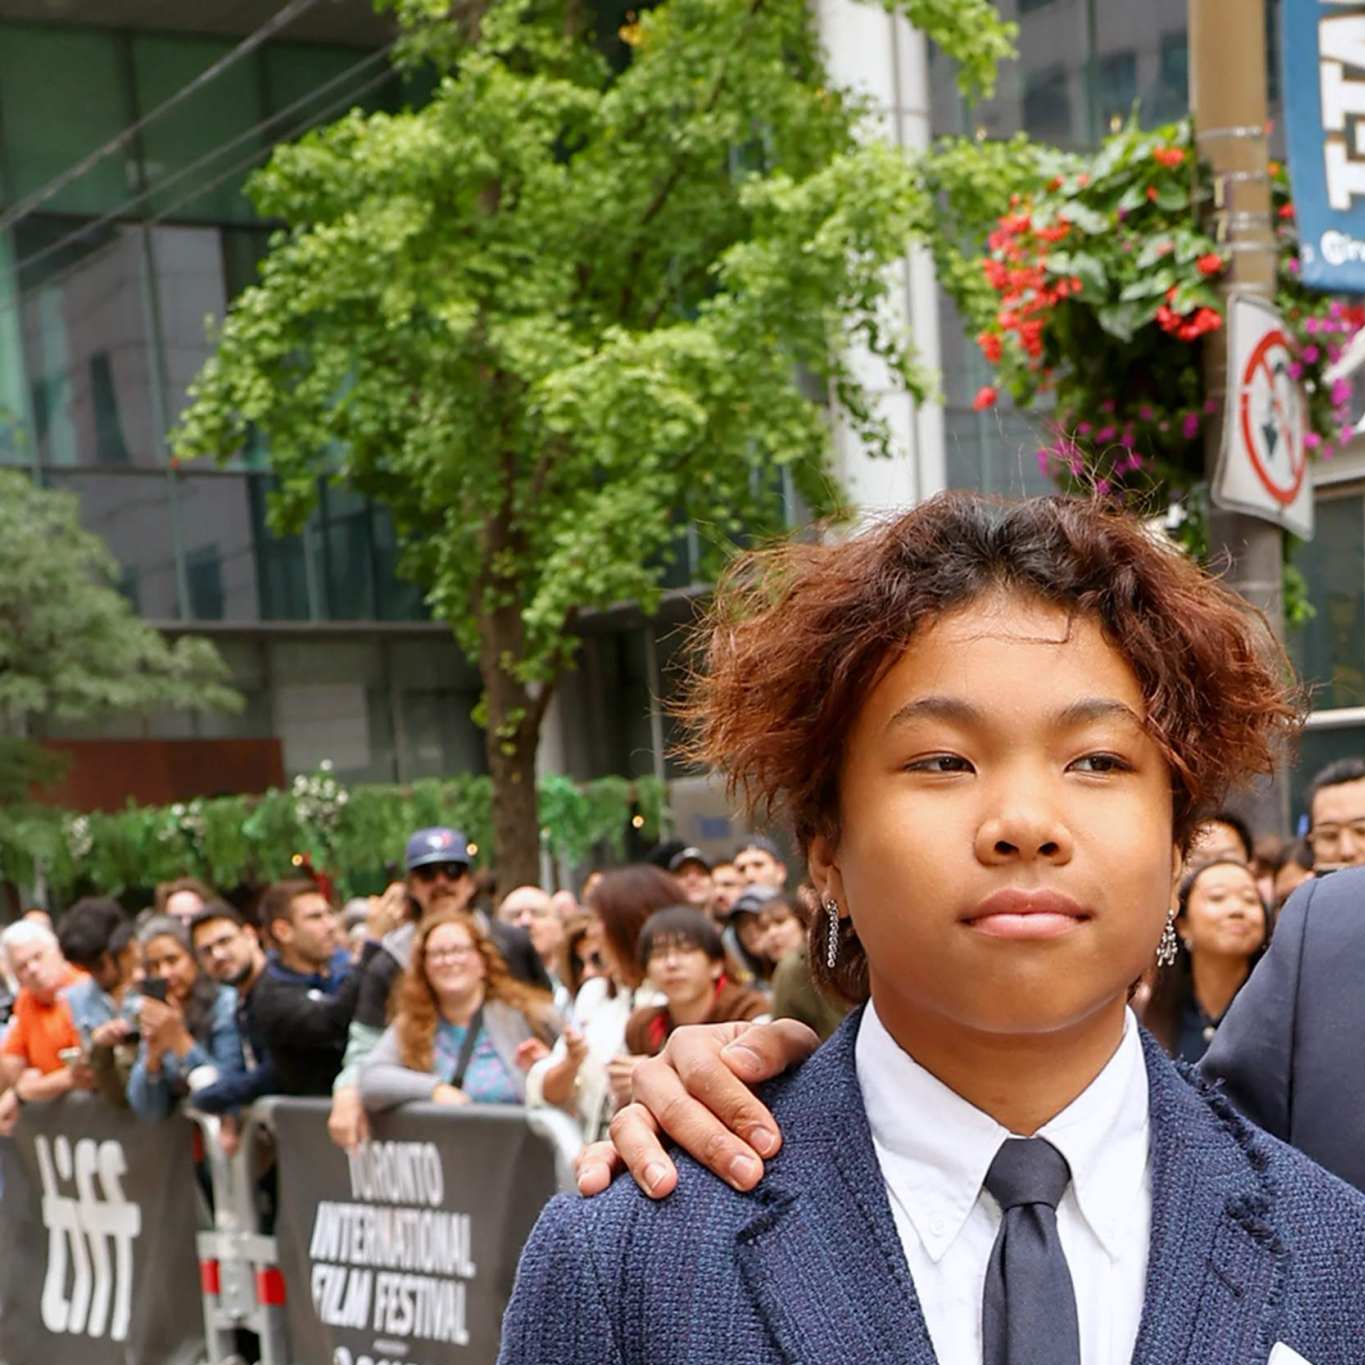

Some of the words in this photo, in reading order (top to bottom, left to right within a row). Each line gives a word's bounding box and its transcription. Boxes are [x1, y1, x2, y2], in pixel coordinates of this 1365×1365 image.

[309, 1201, 477, 1279] INTERNATIONAL
[311, 1263, 373, 1330] FILM
[373, 1271, 470, 1347] FESTIVAL
